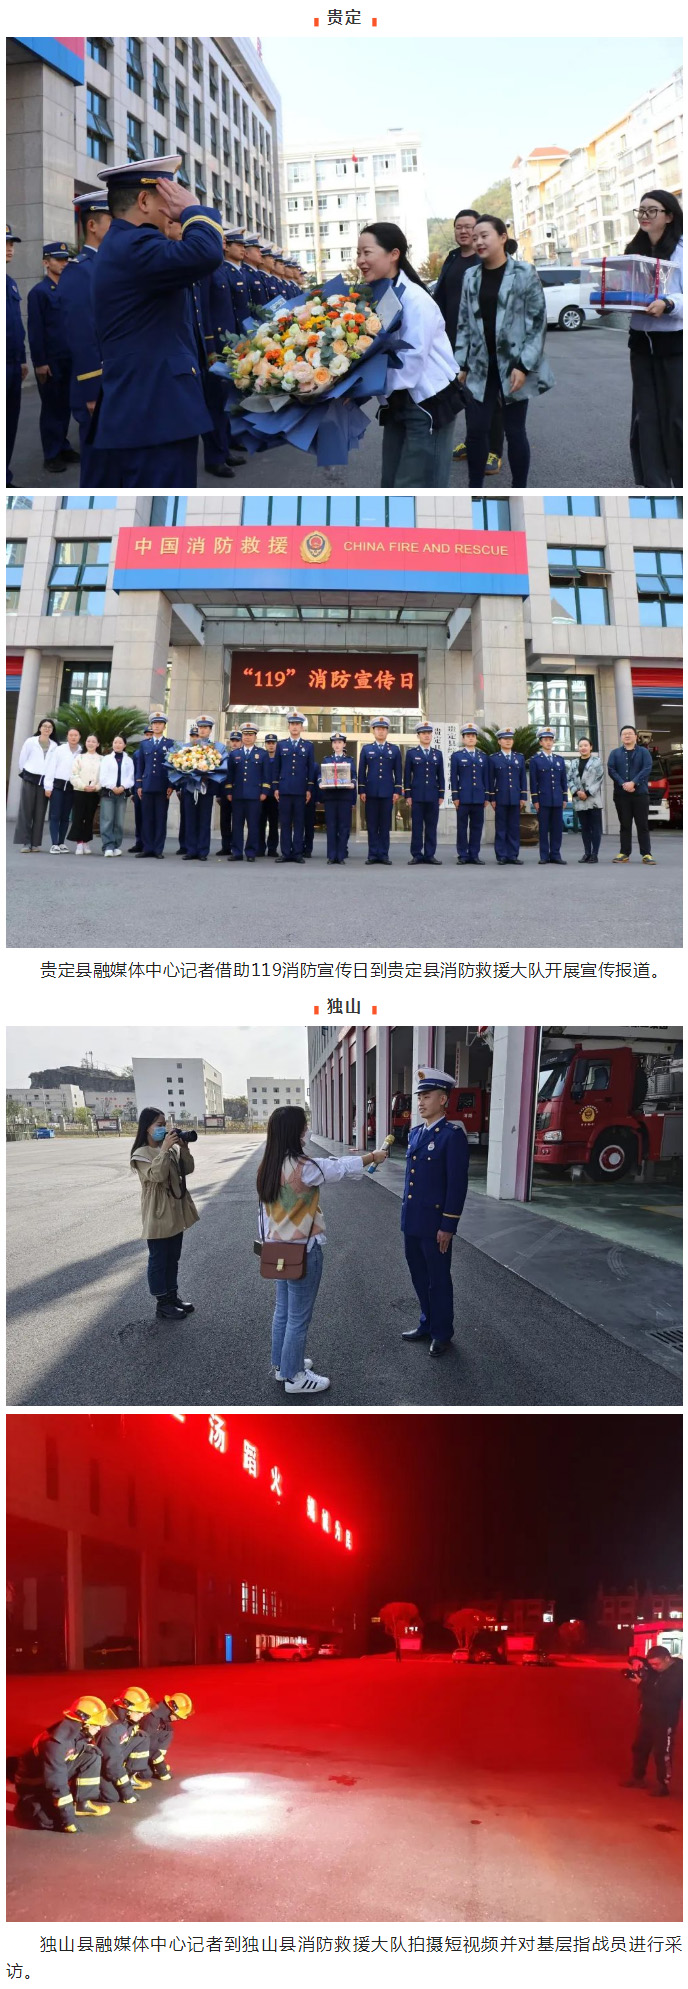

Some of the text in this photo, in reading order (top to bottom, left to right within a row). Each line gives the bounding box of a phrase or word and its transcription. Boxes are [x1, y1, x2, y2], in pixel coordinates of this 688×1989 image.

[134, 535, 289, 555] 中国消防救援
[343, 541, 510, 556] CHINA FIRE AND RESCUE
[171, 1414, 283, 1497] 汤蹈火
